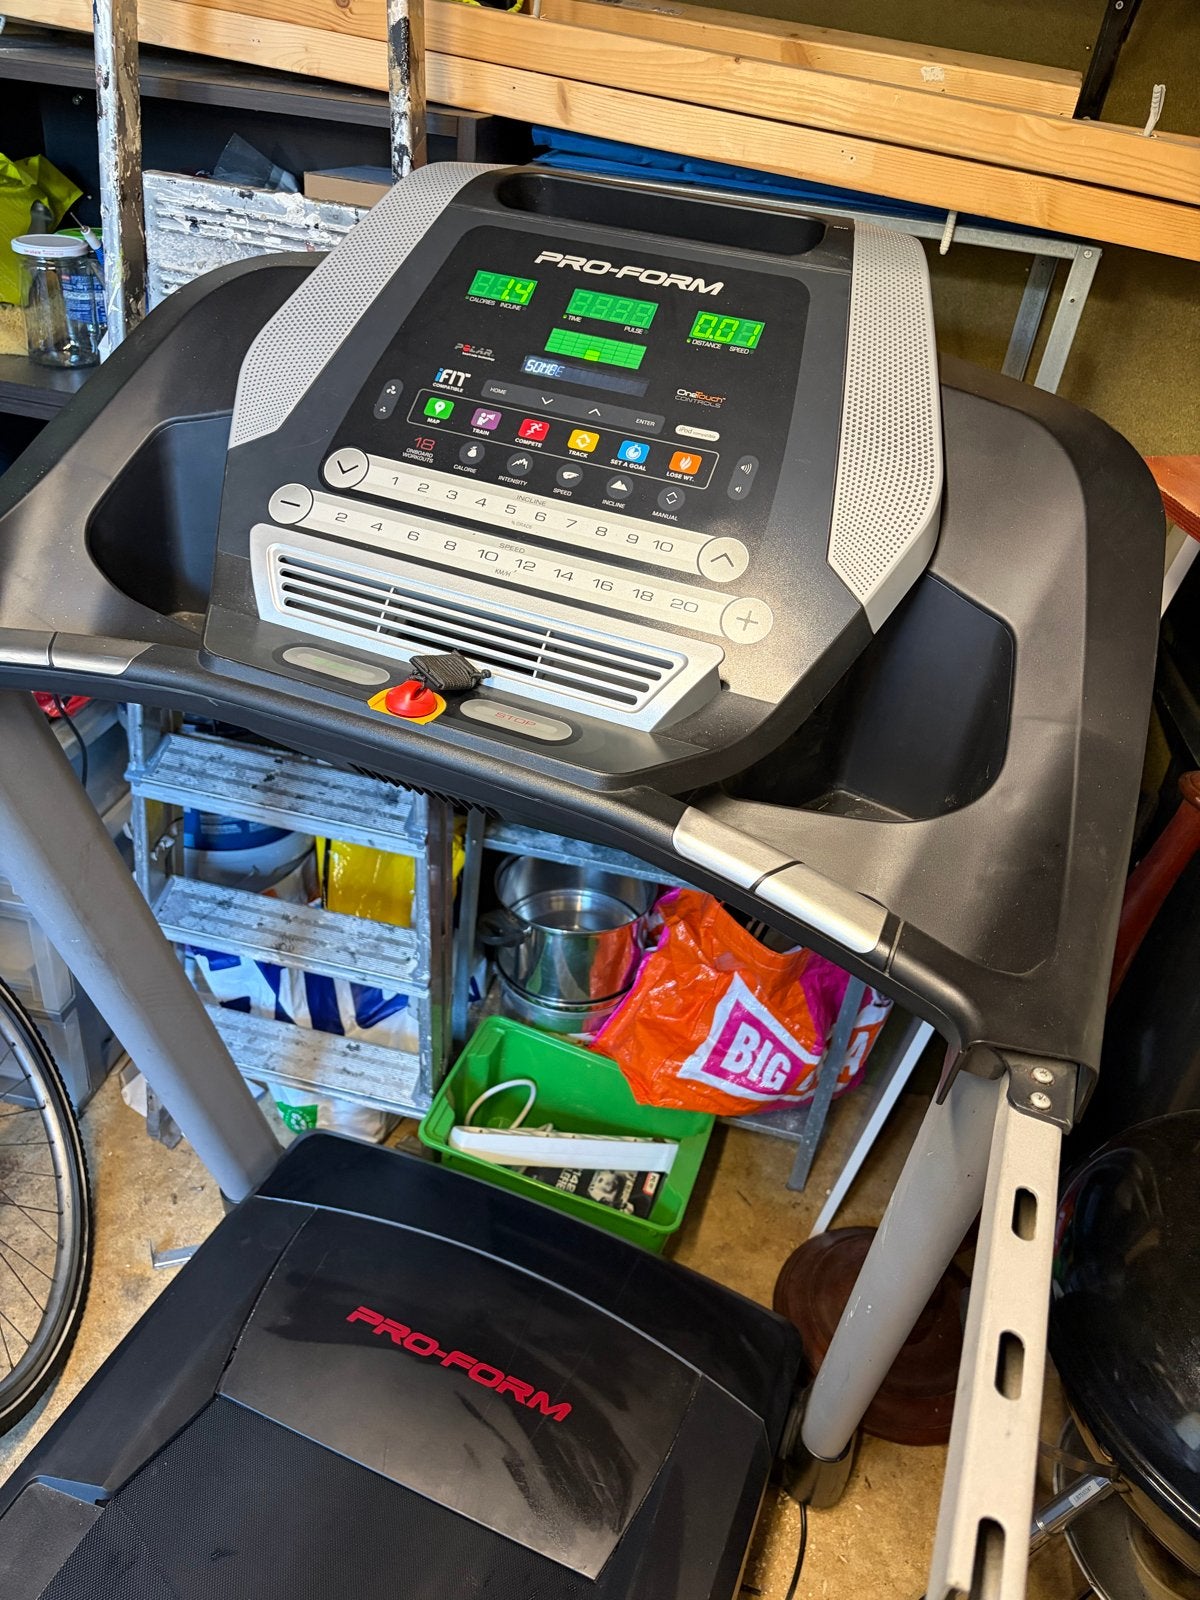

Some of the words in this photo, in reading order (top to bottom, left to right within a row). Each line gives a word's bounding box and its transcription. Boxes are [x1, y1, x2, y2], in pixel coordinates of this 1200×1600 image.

[534, 251, 724, 295] PRO-FORM
[470, 296, 496, 306] CALORIES
[500, 302, 522, 311] INCLINE
[568, 315, 582, 323] TIME
[624, 326, 644, 334] PULSE
[454, 342, 493, 356] POLAR
[692, 339, 722, 350] DISTANCE
[730, 346, 749, 355] SPEED
[432, 382, 464, 392] COMPATIBLE
[490, 387, 507, 396] HOME
[674, 395, 721, 408] CONTROLS
[636, 418, 656, 428] ENTER
[472, 428, 490, 436] TRAIN
[414, 436, 436, 450] 18
[514, 438, 542, 448] COMPETE
[402, 452, 434, 464] WORKOUTS
[406, 448, 434, 458] ONBOARD
[568, 450, 588, 458] TRACK
[453, 464, 478, 474] CALORIE
[629, 463, 646, 472] GOAL
[498, 476, 528, 486] INTENSITY
[666, 472, 682, 480] LOSE
[552, 488, 572, 497] SPEED
[516, 494, 546, 506] INCLINE
[602, 499, 626, 510] INCLINE
[392, 476, 399, 486] 1
[417, 483, 430, 493] 2
[446, 490, 458, 500] 3
[474, 498, 486, 508] 4
[504, 504, 516, 514] 5
[534, 512, 547, 522] 6
[566, 518, 578, 528] 7
[595, 526, 608, 536] 8
[626, 534, 640, 544] 9
[652, 540, 674, 552] 10
[652, 510, 678, 522] MANUAL
[499, 543, 525, 554] SPEED
[335, 512, 348, 522] 2
[370, 522, 383, 532] 4
[408, 530, 420, 541] 6
[444, 540, 457, 551] 8
[478, 549, 499, 562] 10
[514, 558, 536, 572] 12
[554, 568, 574, 582] 14
[592, 578, 614, 592] 16
[632, 588, 654, 602] 18
[670, 598, 699, 613] 20
[494, 712, 536, 728] STOP
[720, 1021, 792, 1090] BIG
[346, 1306, 572, 1422] PRO-FORM
